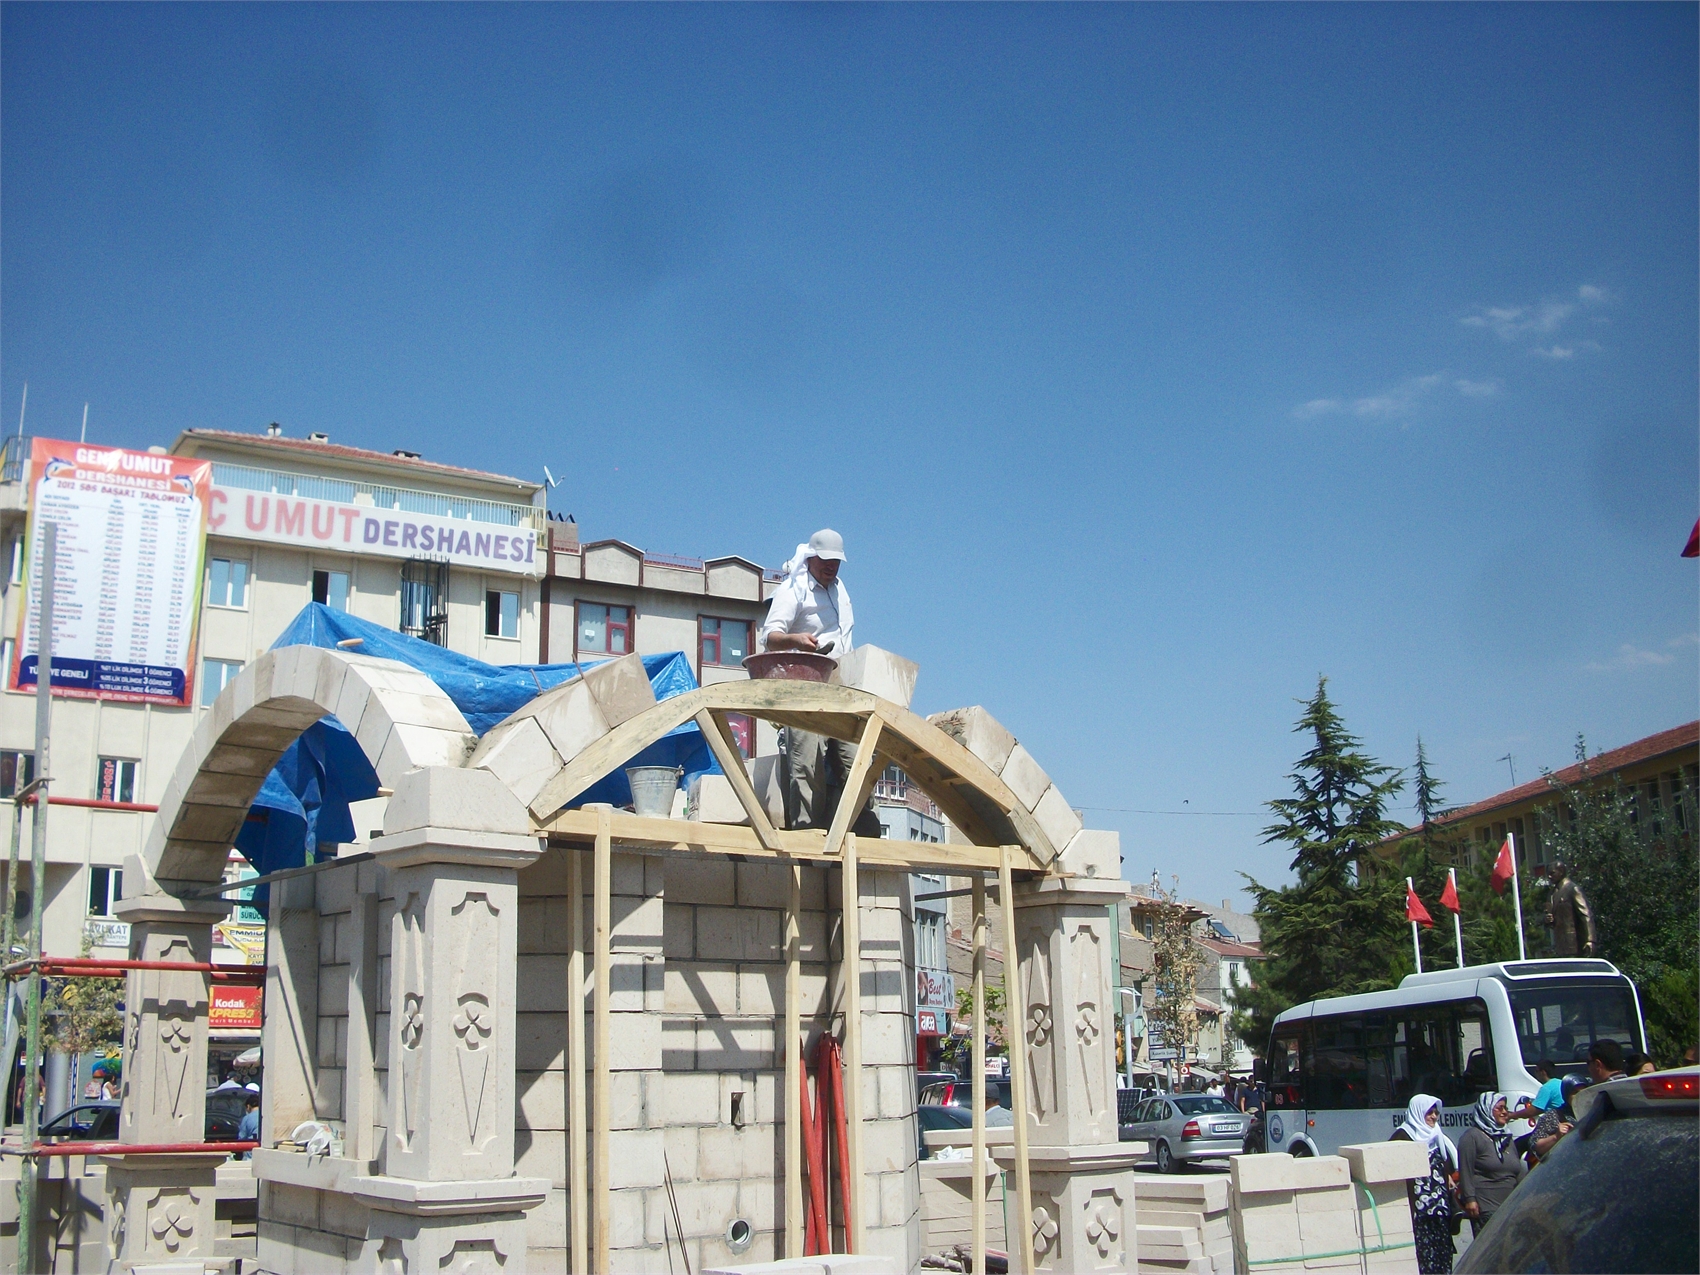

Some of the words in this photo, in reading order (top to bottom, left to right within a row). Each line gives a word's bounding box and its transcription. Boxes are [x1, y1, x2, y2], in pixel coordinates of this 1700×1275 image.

[76, 448, 121, 472] GEN
[122, 454, 174, 475] UMUT
[75, 469, 171, 490] DERSHANESİ
[57, 481, 75, 490] 2012
[101, 486, 136, 498] BAŞARI
[140, 492, 186, 504] TABLOMUZ
[245, 495, 360, 542] UMUT
[363, 518, 535, 564] DERSHANESİ
[29, 665, 60, 677] TÜYE
[61, 669, 89, 679] GENELİ
[241, 910, 263, 920] SÜRÜC
[215, 998, 245, 1008] Kodak
[209, 1008, 254, 1018] XPRESS
[1440, 1110, 1474, 1127] LEDİYES
